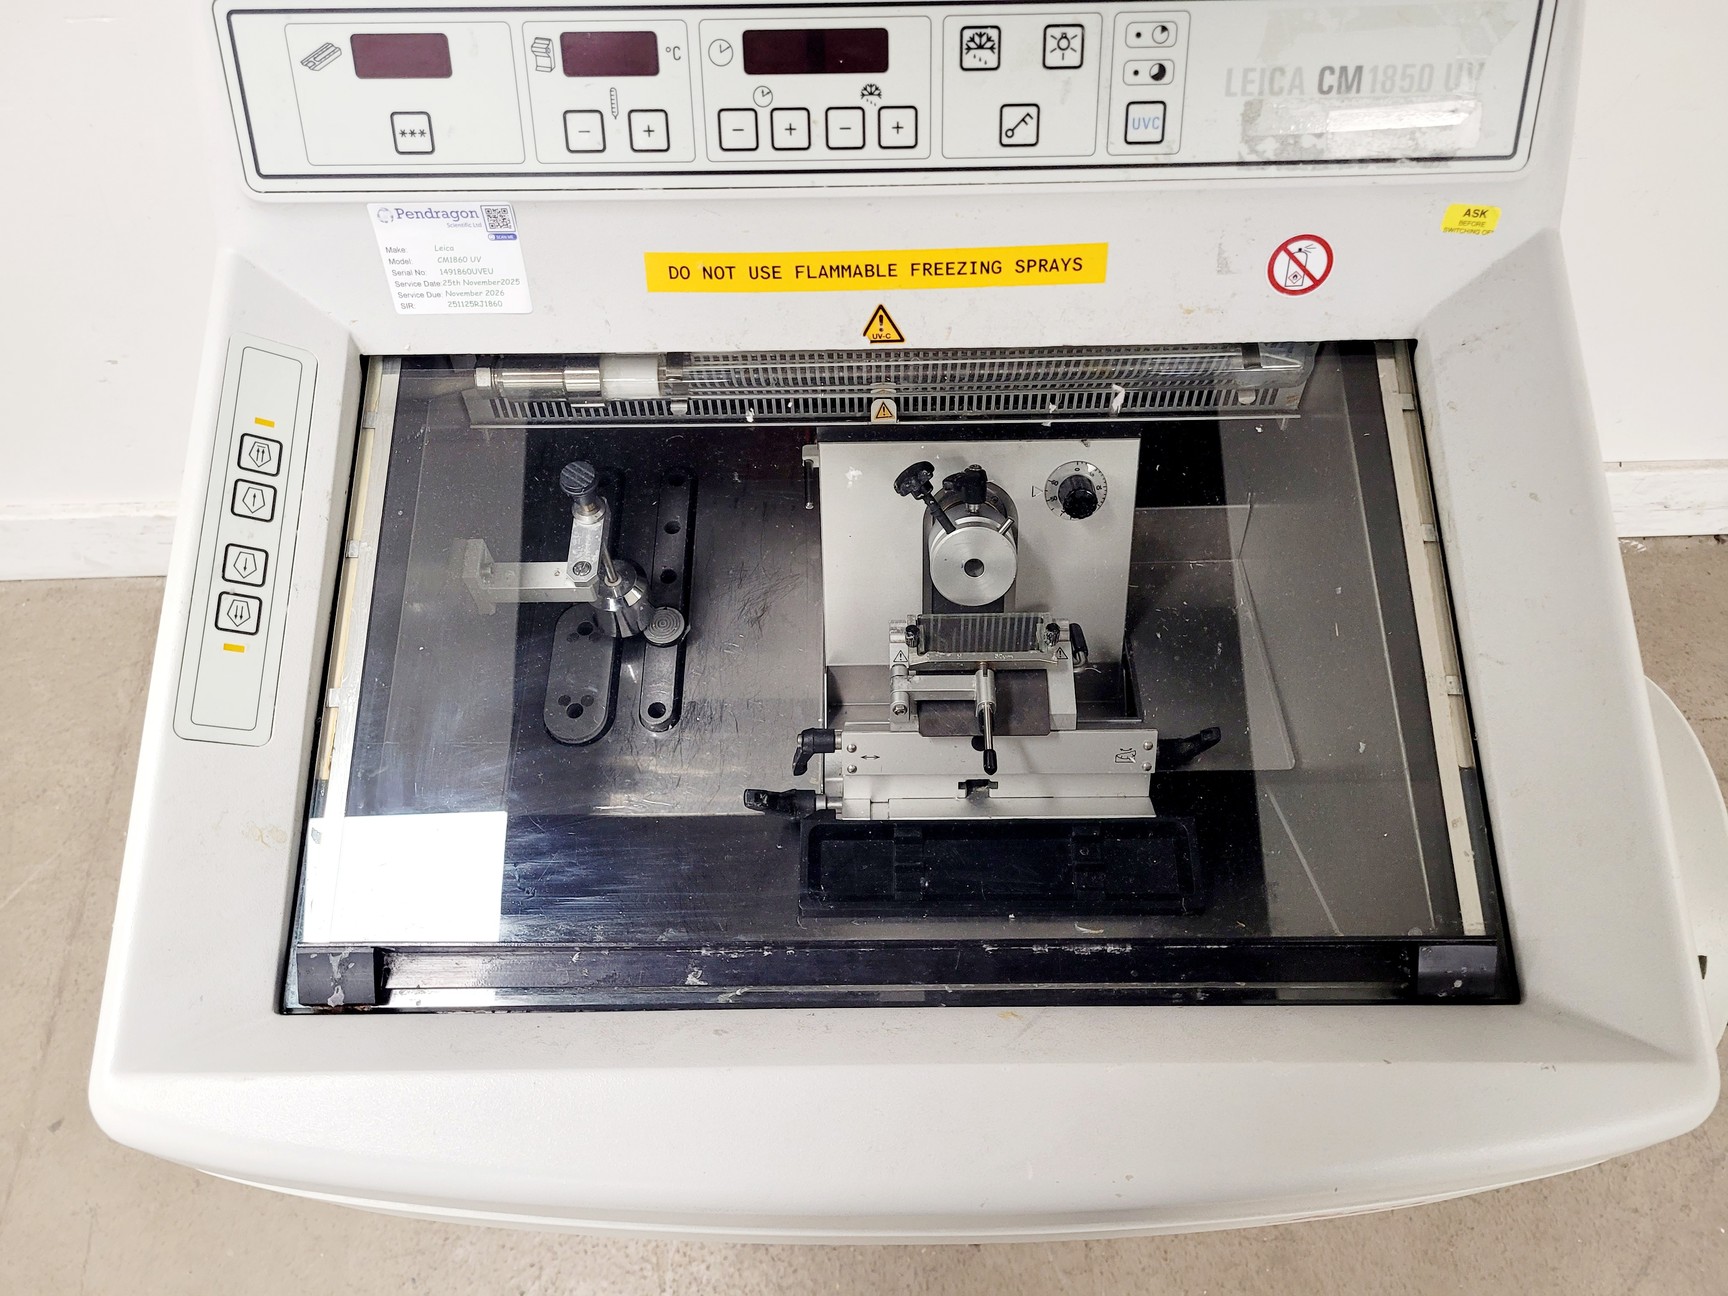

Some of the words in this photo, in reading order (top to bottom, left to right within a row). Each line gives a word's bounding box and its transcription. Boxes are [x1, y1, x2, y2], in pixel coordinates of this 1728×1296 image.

[1225, 66, 1305, 97] LEICA
[1132, 117, 1160, 130] UVC
[394, 208, 480, 222] Pendragon
[1462, 208, 1488, 218] ASK
[668, 265, 690, 281] DO
[702, 265, 737, 281] NOT
[748, 264, 783, 280] USE
[794, 263, 898, 280] FLAMMABLE
[910, 259, 1003, 277] FREEZING
[1015, 257, 1084, 274] SPRAYS
[394, 280, 422, 288] Service
